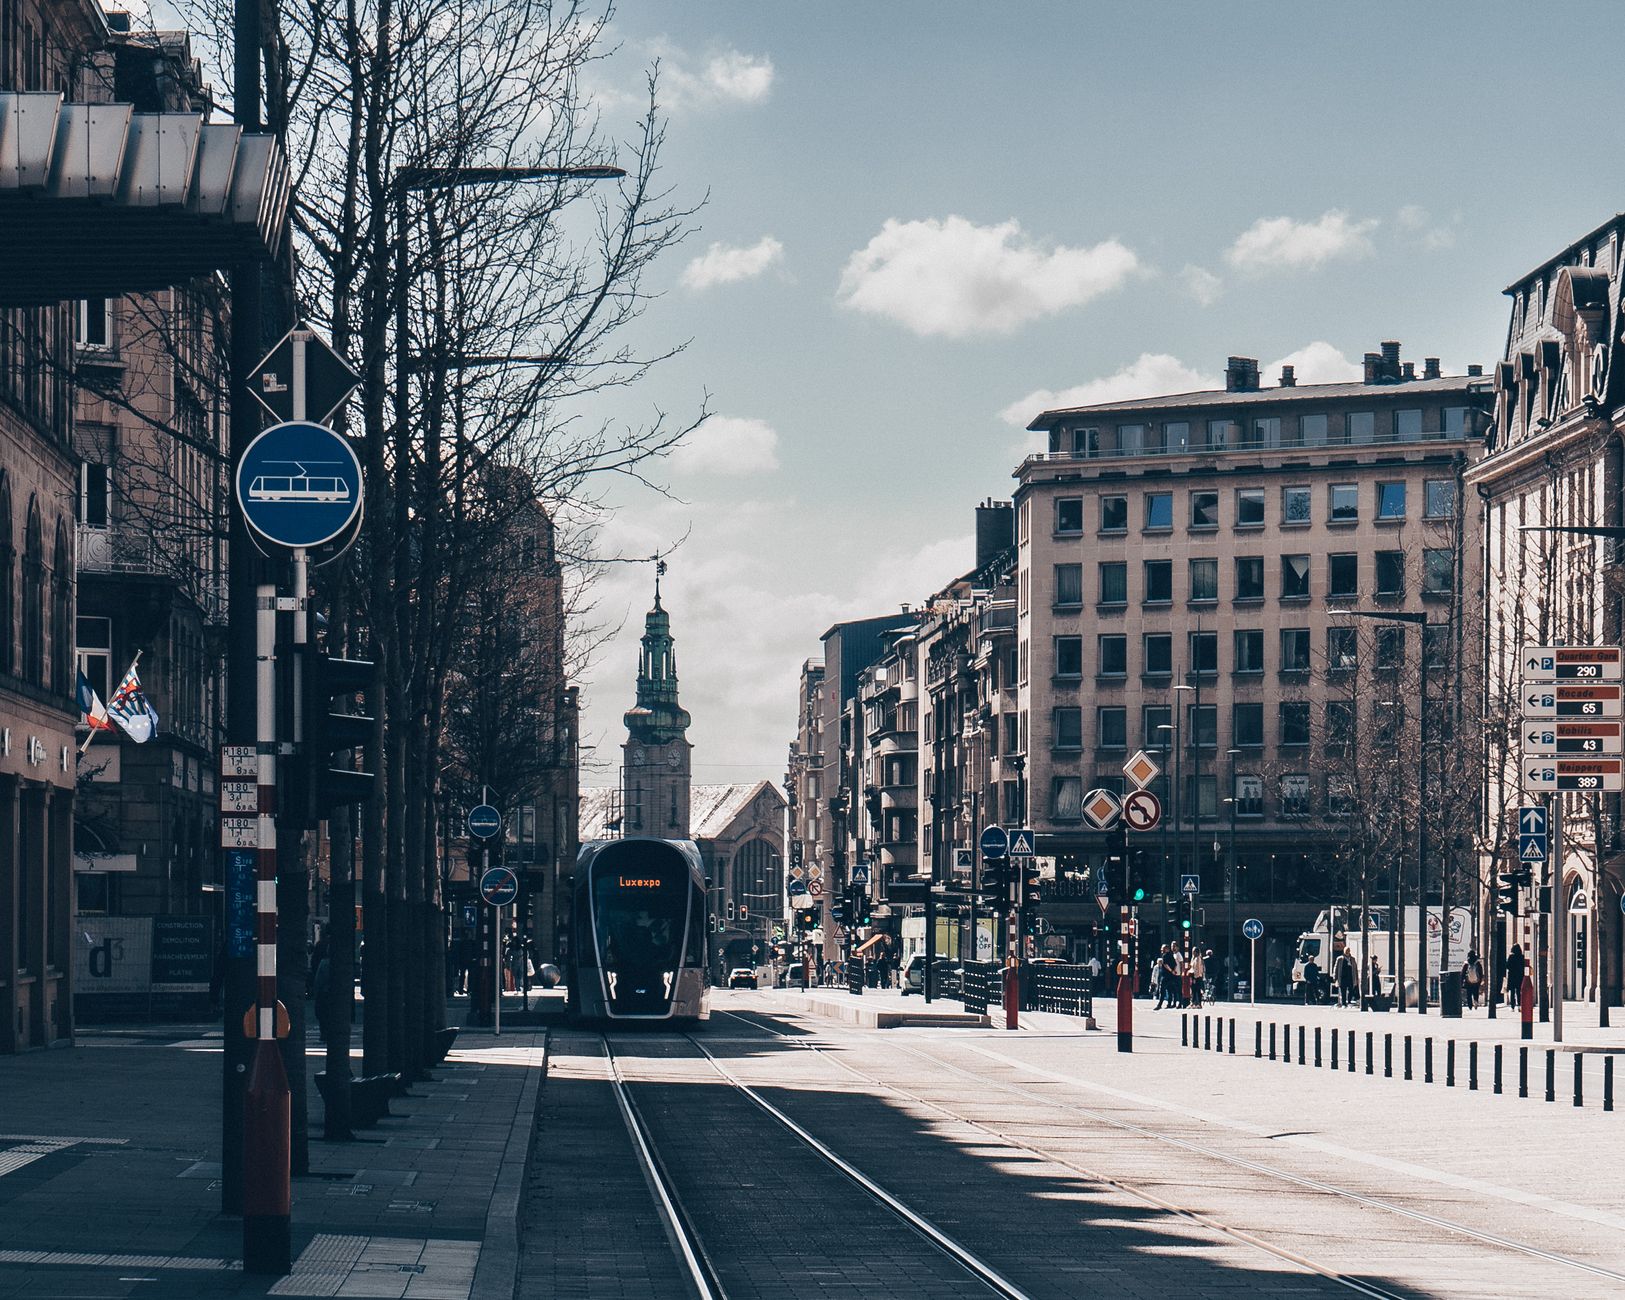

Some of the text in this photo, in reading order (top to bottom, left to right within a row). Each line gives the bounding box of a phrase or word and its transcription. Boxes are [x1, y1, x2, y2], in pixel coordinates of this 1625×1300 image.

[1558, 651, 1617, 662] Quartier Gare
[1577, 666, 1597, 677] 290
[1558, 689, 1594, 698] Rocade
[1582, 703, 1596, 714] 65
[1558, 726, 1592, 735] Nobilis
[1582, 740, 1597, 750] 43
[1559, 763, 1602, 773] Neipperg
[1577, 777, 1598, 787] 389
[619, 876, 661, 888] Luxexpo
